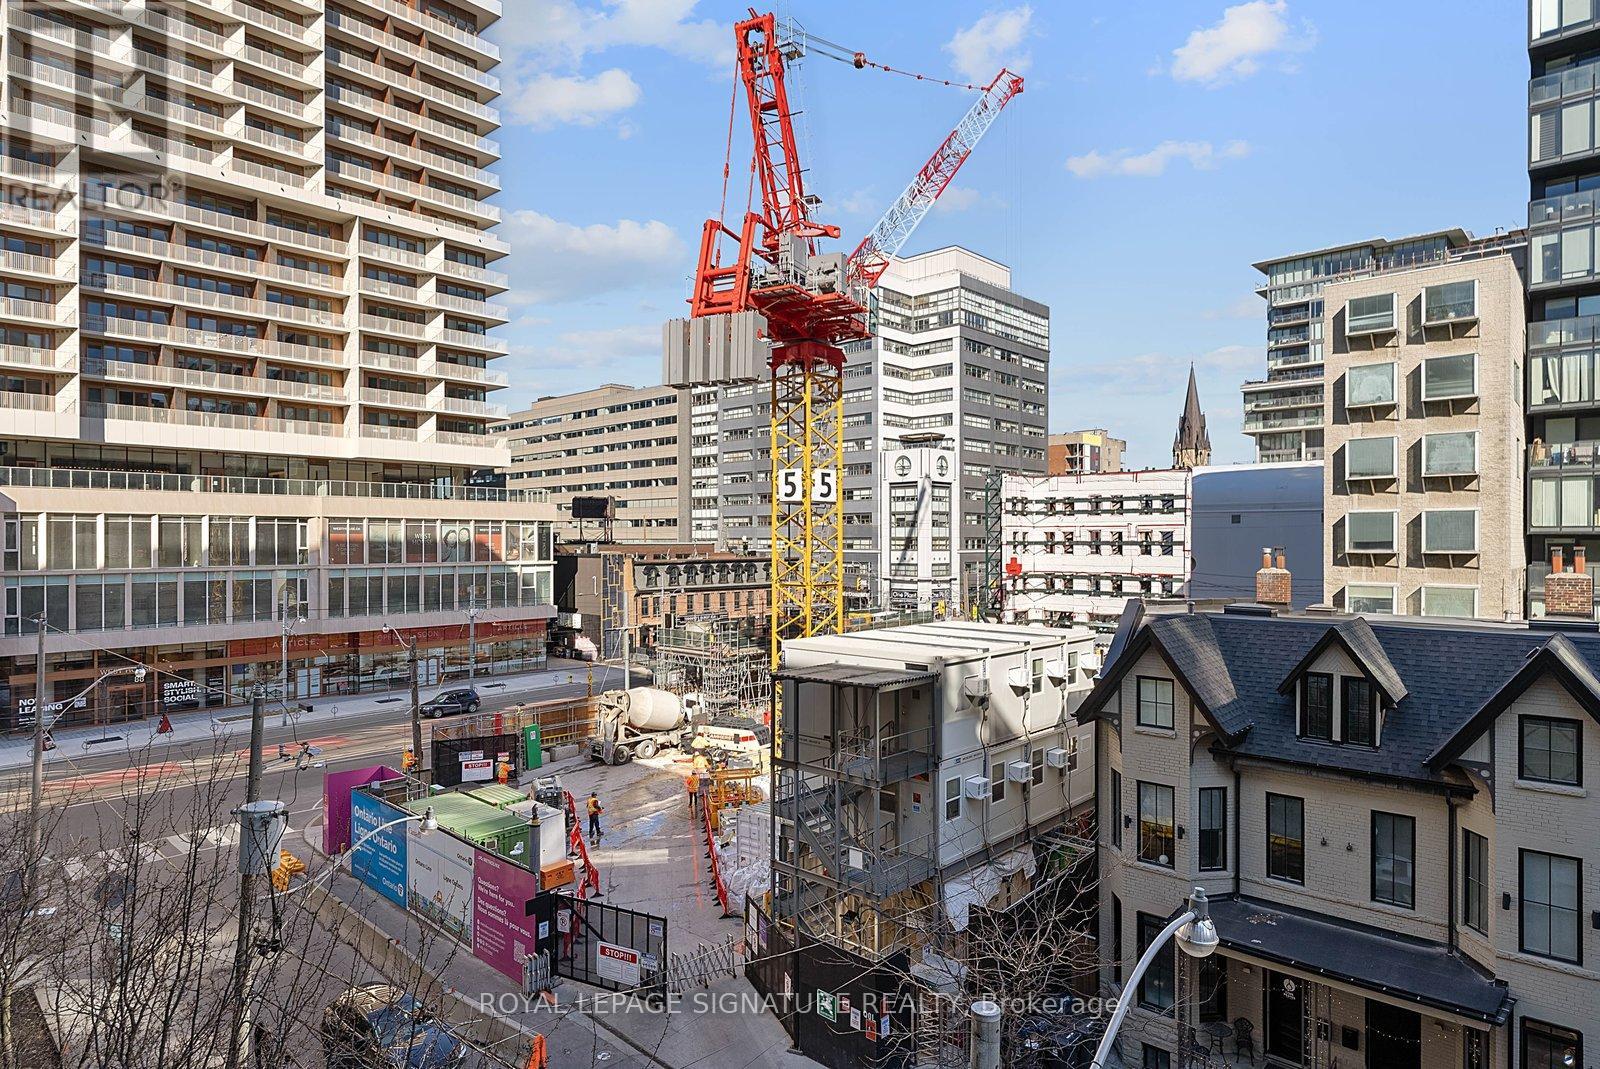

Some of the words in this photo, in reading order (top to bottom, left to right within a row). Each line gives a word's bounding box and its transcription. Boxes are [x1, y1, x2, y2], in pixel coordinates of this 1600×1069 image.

[18, 697, 46, 706] NO
[18, 703, 63, 714] LEAING
[354, 805, 378, 827] Ontario
[372, 833, 397, 854] Ontario
[605, 948, 632, 962] STOP!!!
